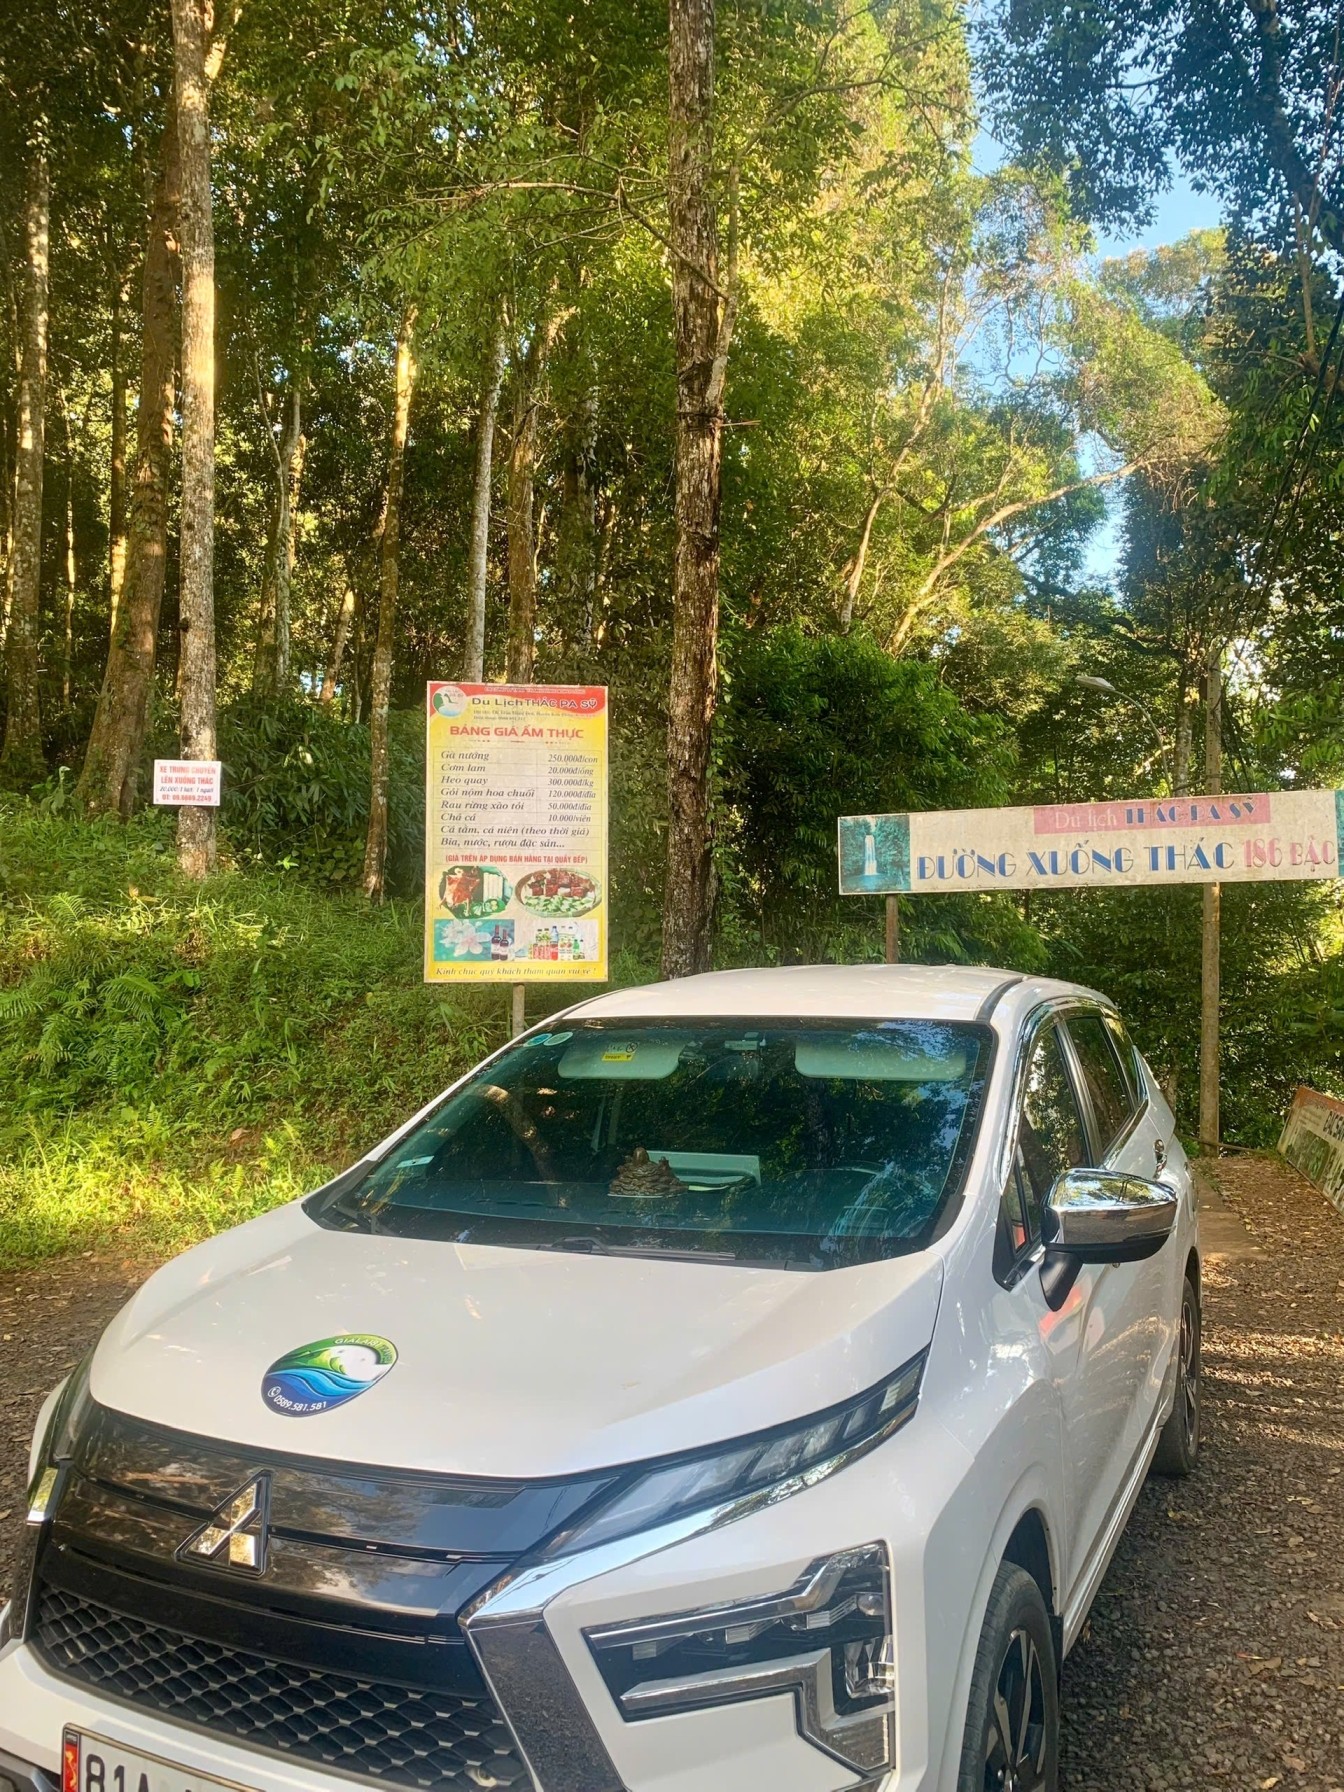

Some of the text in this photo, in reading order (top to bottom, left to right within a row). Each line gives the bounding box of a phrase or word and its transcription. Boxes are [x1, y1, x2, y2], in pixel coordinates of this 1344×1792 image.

[471, 697, 490, 706] Du
[495, 697, 525, 707] Lịch
[525, 697, 556, 708] THÁC
[560, 699, 578, 708] PA
[450, 723, 491, 736] BẢNG
[494, 723, 518, 737] GIÁ
[547, 727, 585, 740] THỰC
[441, 750, 598, 764] Gà nướng 250.000đ/con
[170, 766, 189, 774] TRUNG
[441, 763, 594, 776] Cơm lam 20.000đ/ống
[161, 775, 213, 785] LÊN XUỐNG THÁC
[441, 775, 594, 788] Heo quay 300.000đ/kg
[485, 788, 504, 797] hoa
[507, 787, 535, 798] chuối
[548, 790, 596, 799] 120.000đ/đĩa
[441, 800, 462, 809] Rau
[464, 800, 488, 811] rừng
[491, 801, 509, 810] xào
[548, 802, 592, 811] 50.000đ/đĩa
[464, 813, 476, 821] cá
[548, 813, 591, 823] 10.000/viên
[1055, 796, 1258, 829] Du lịch THÁC PA SỸ
[441, 825, 456, 834] Cá
[483, 826, 495, 835] cá
[497, 826, 518, 835] niên
[521, 826, 547, 836] (theo
[549, 826, 569, 835] thời
[571, 826, 590, 837] giá)
[441, 837, 460, 847] Bia,
[463, 839, 490, 848] nước,
[493, 839, 518, 848] rượu
[520, 838, 537, 849] đặc
[446, 854, 460, 863] (GIÁ
[461, 854, 478, 863] TRÊN
[479, 854, 488, 863] ÁP
[489, 855, 508, 864] DỤNG
[524, 854, 542, 864] HÀNG
[543, 855, 554, 865] TẠI
[573, 854, 588, 865] BẾP)
[917, 834, 1336, 880] ĐƯỜNG XUỐNG THÁC 186 BẬC
[436, 967, 456, 975] Kính
[497, 967, 521, 975] khách
[524, 967, 544, 975] tham
[546, 968, 565, 977] quan
[273, 1393, 327, 1412] 0589.581.581
